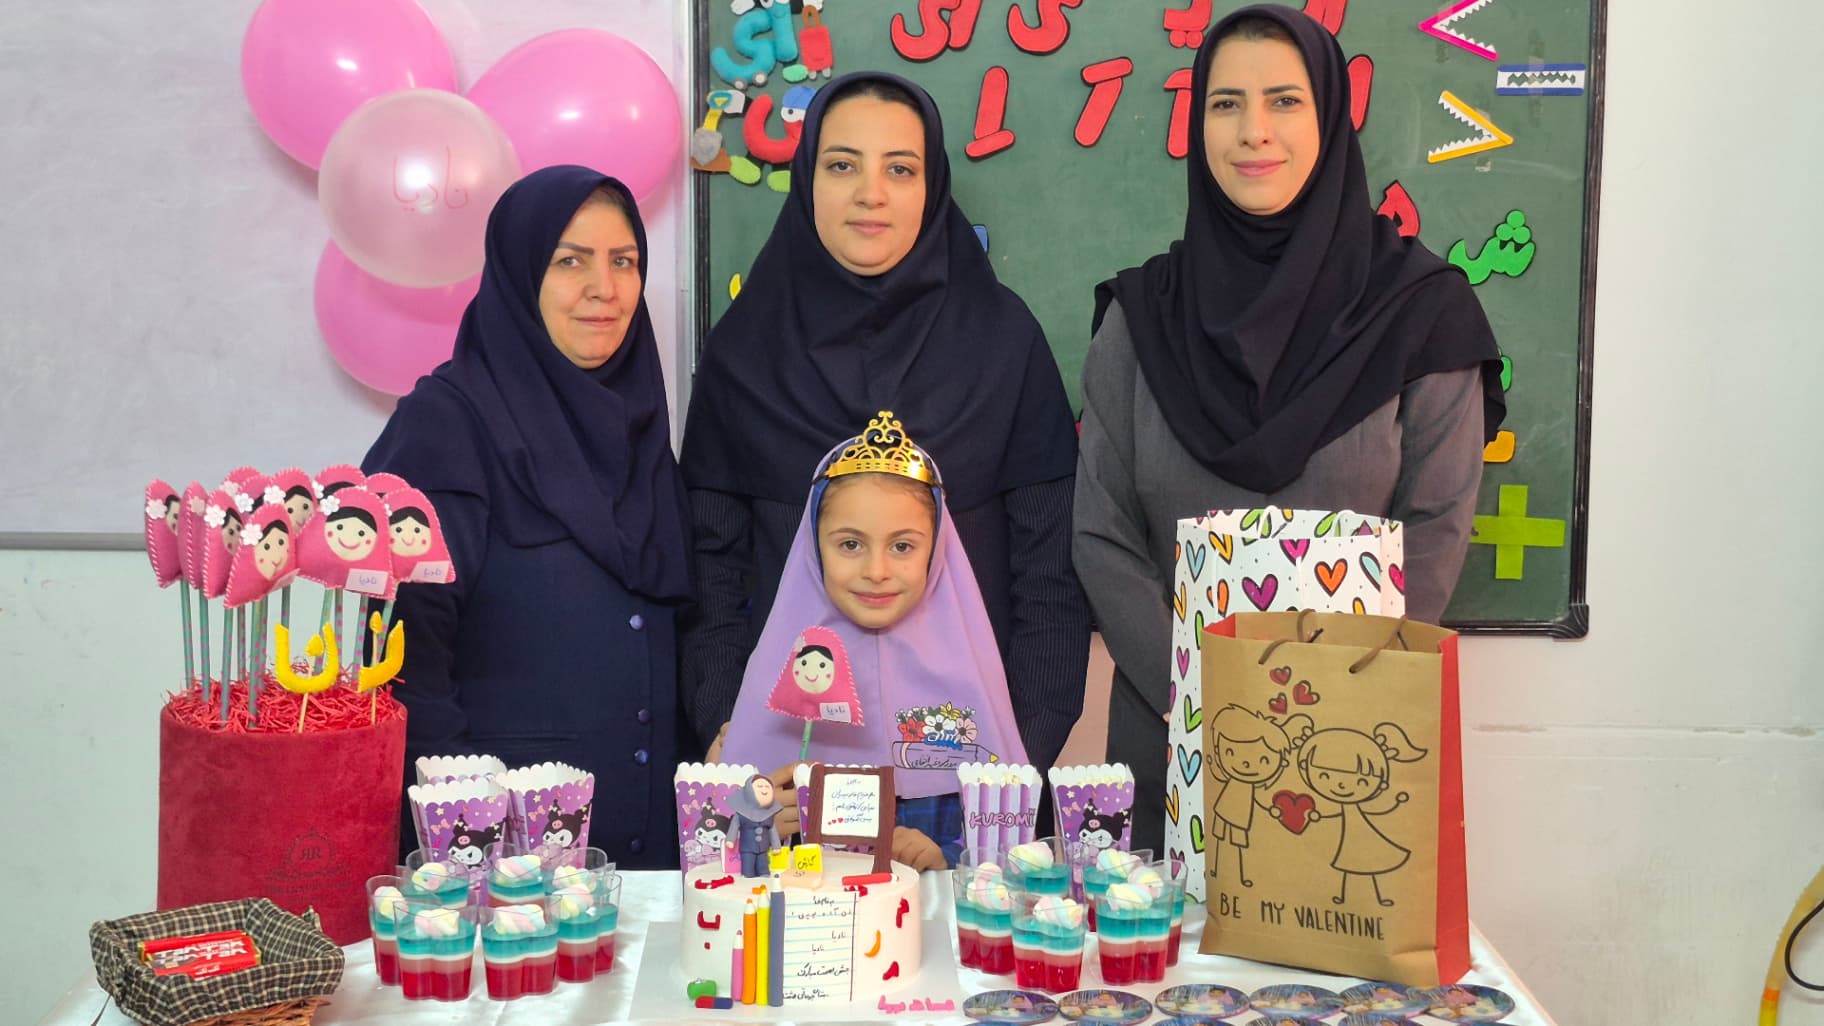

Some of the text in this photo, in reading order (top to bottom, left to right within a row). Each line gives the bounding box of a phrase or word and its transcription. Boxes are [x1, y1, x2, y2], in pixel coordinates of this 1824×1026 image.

[1219, 892, 1385, 940] BE MY VALENTINE
